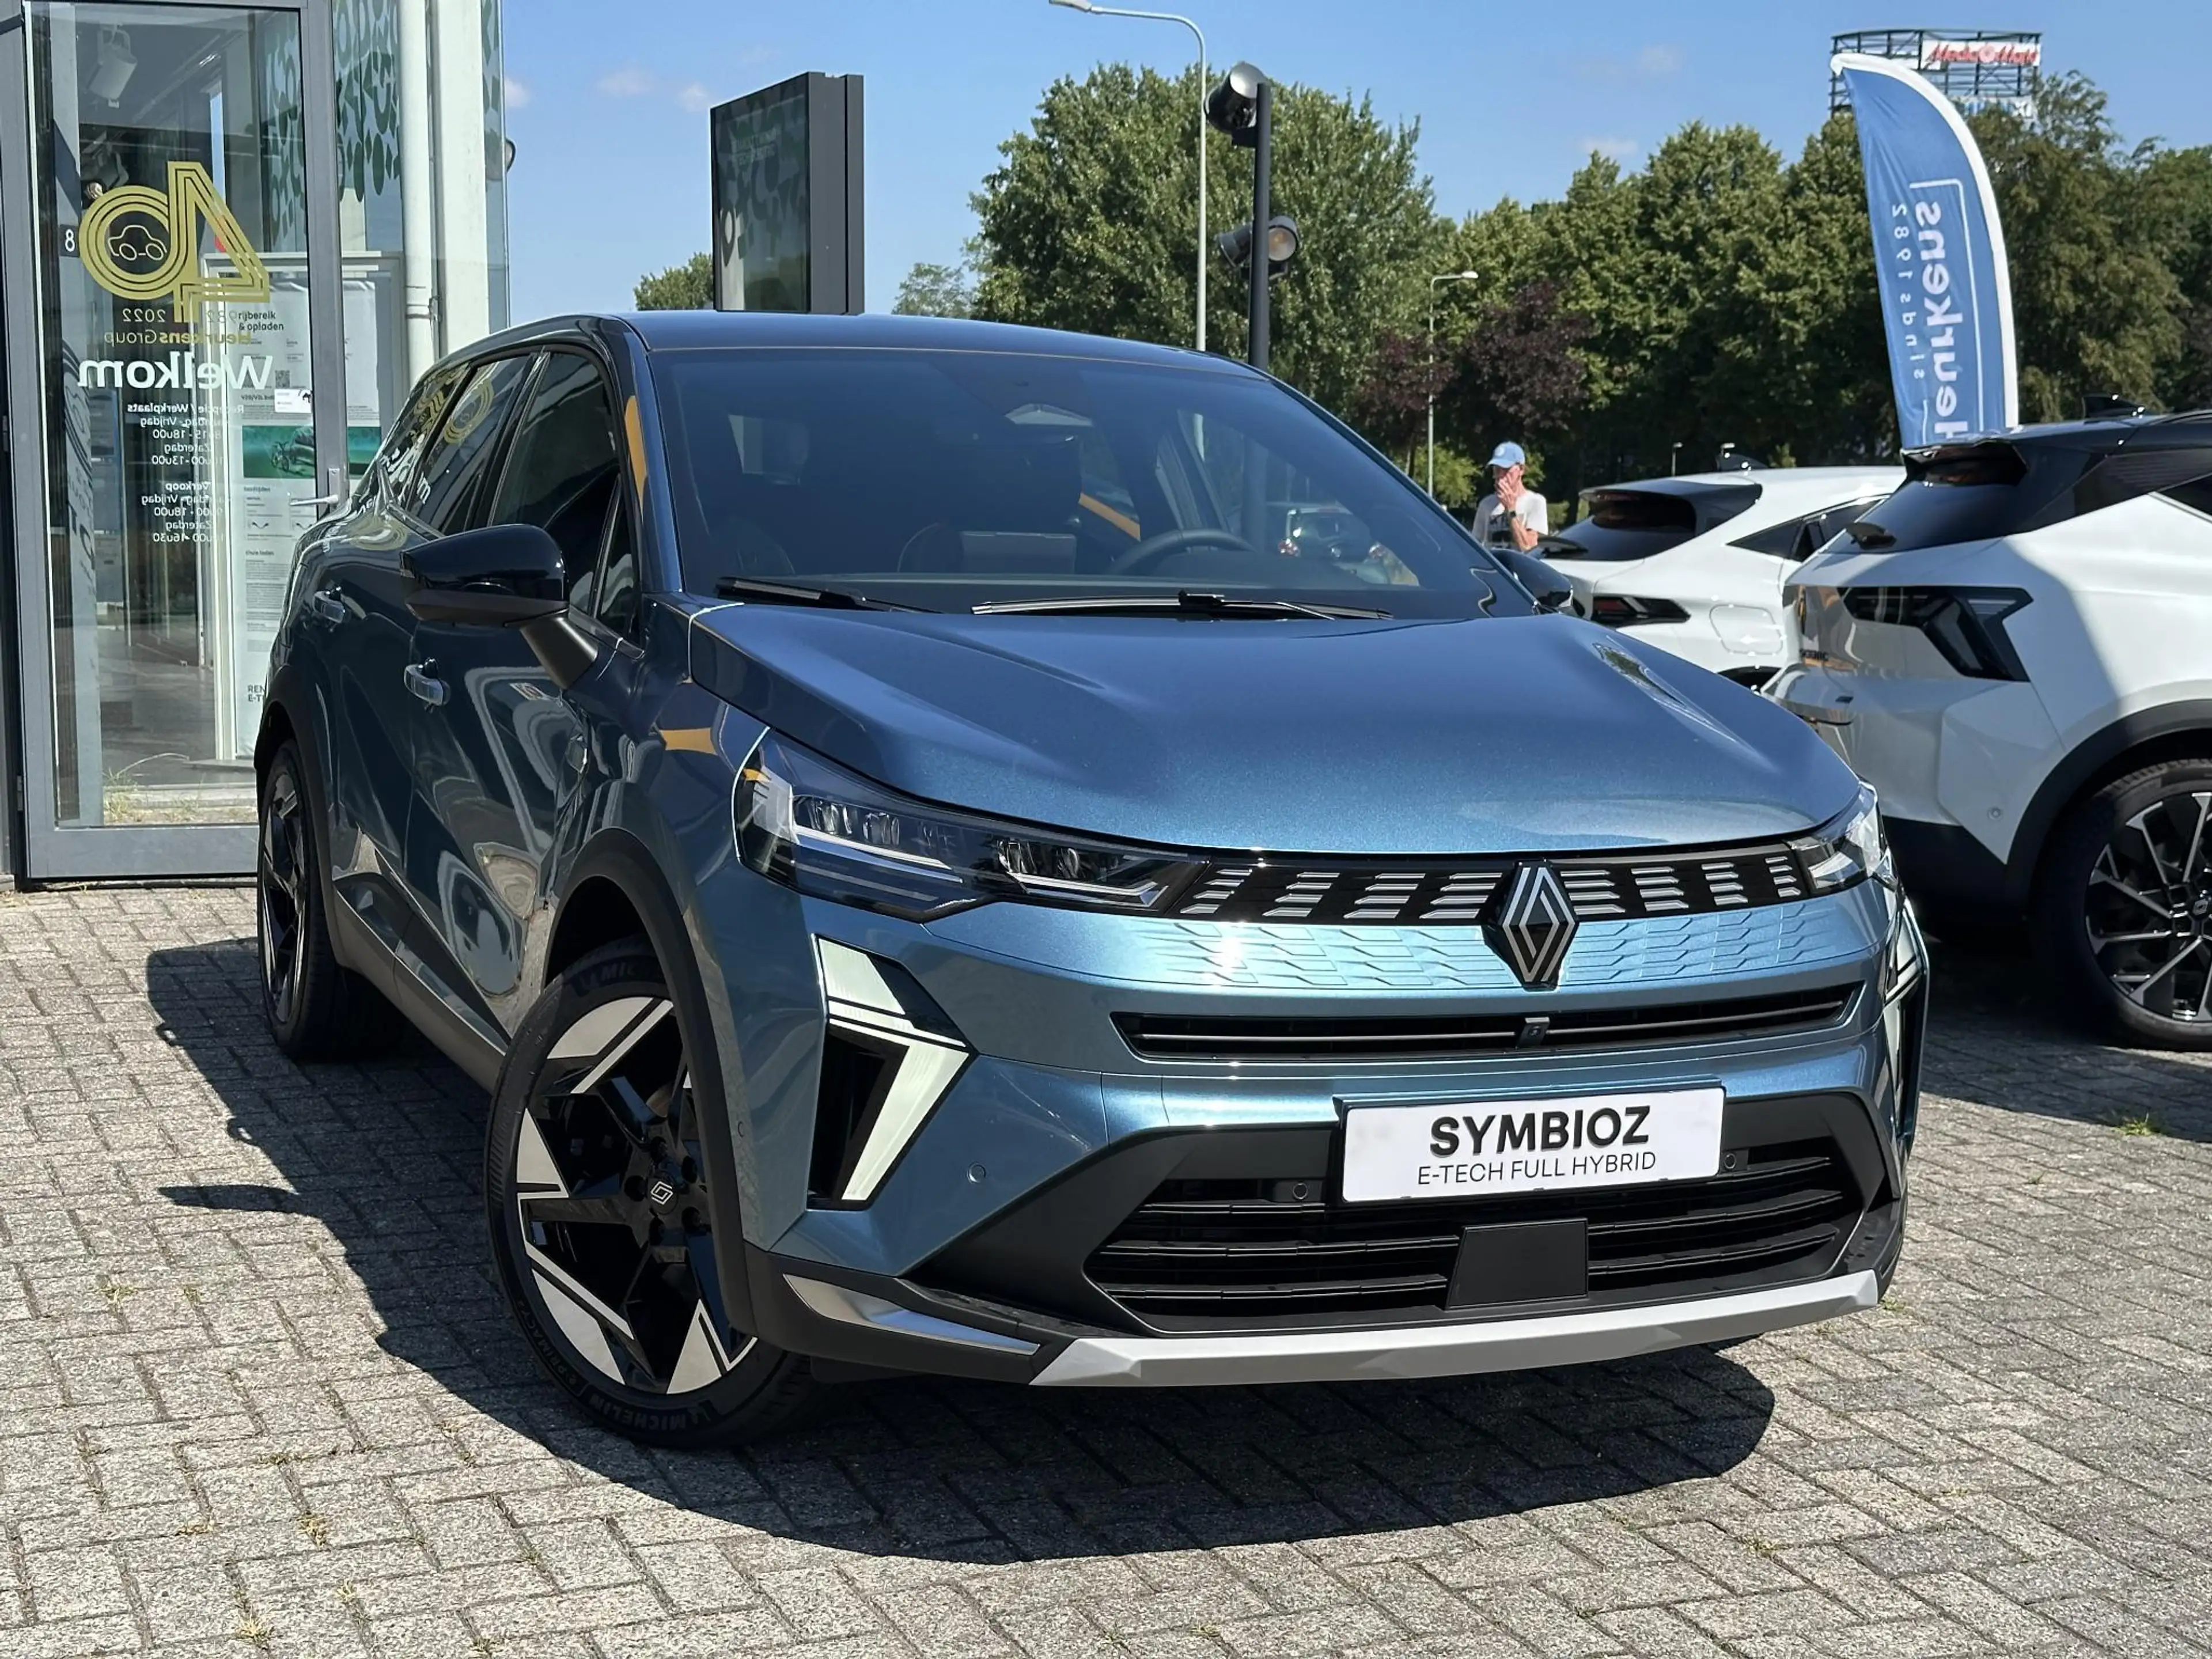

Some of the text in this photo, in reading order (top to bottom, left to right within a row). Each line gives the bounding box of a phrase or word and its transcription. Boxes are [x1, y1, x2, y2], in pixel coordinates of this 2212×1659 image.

[238, 311, 276, 321] rijbereik
[1429, 1105, 1651, 1158] SYMBIOZ
[1418, 1151, 1656, 1185] E-TECH FULL HYBRID
[588, 1394, 688, 1432] MICHELIN
